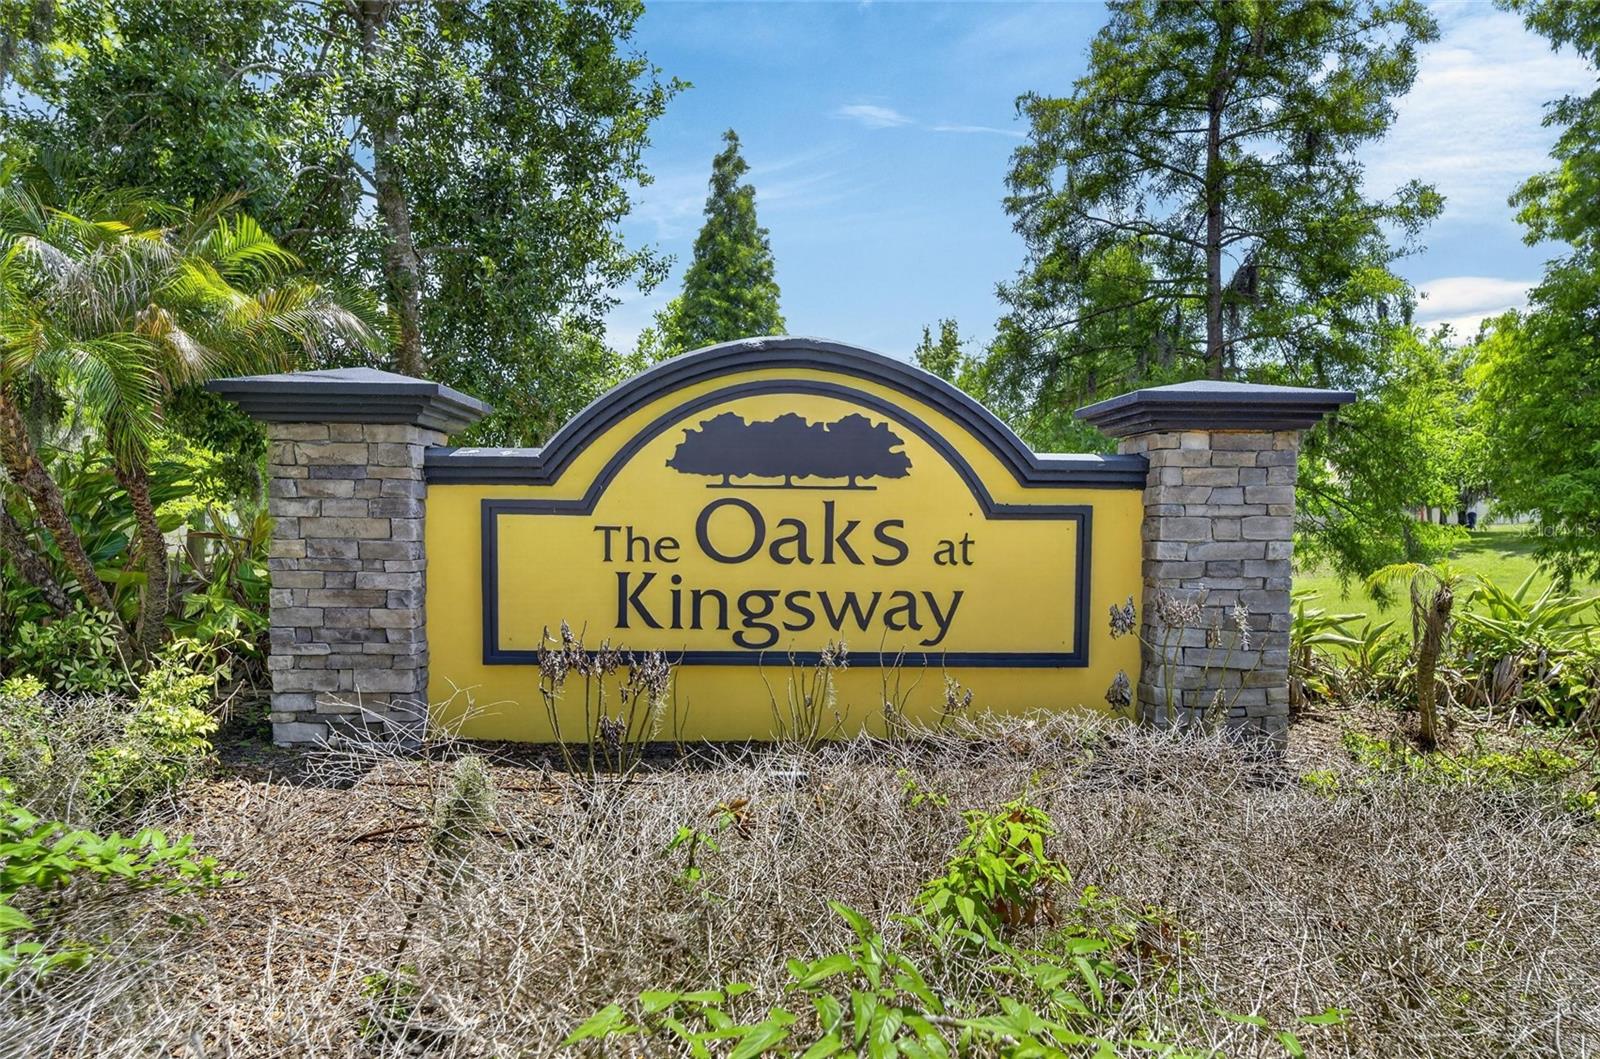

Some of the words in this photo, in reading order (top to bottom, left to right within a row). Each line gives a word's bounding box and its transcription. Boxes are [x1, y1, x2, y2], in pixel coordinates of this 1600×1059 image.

[593, 525, 680, 563] The
[695, 498, 909, 566] Oaks
[933, 532, 975, 566] at
[614, 571, 965, 649] Kingsway
